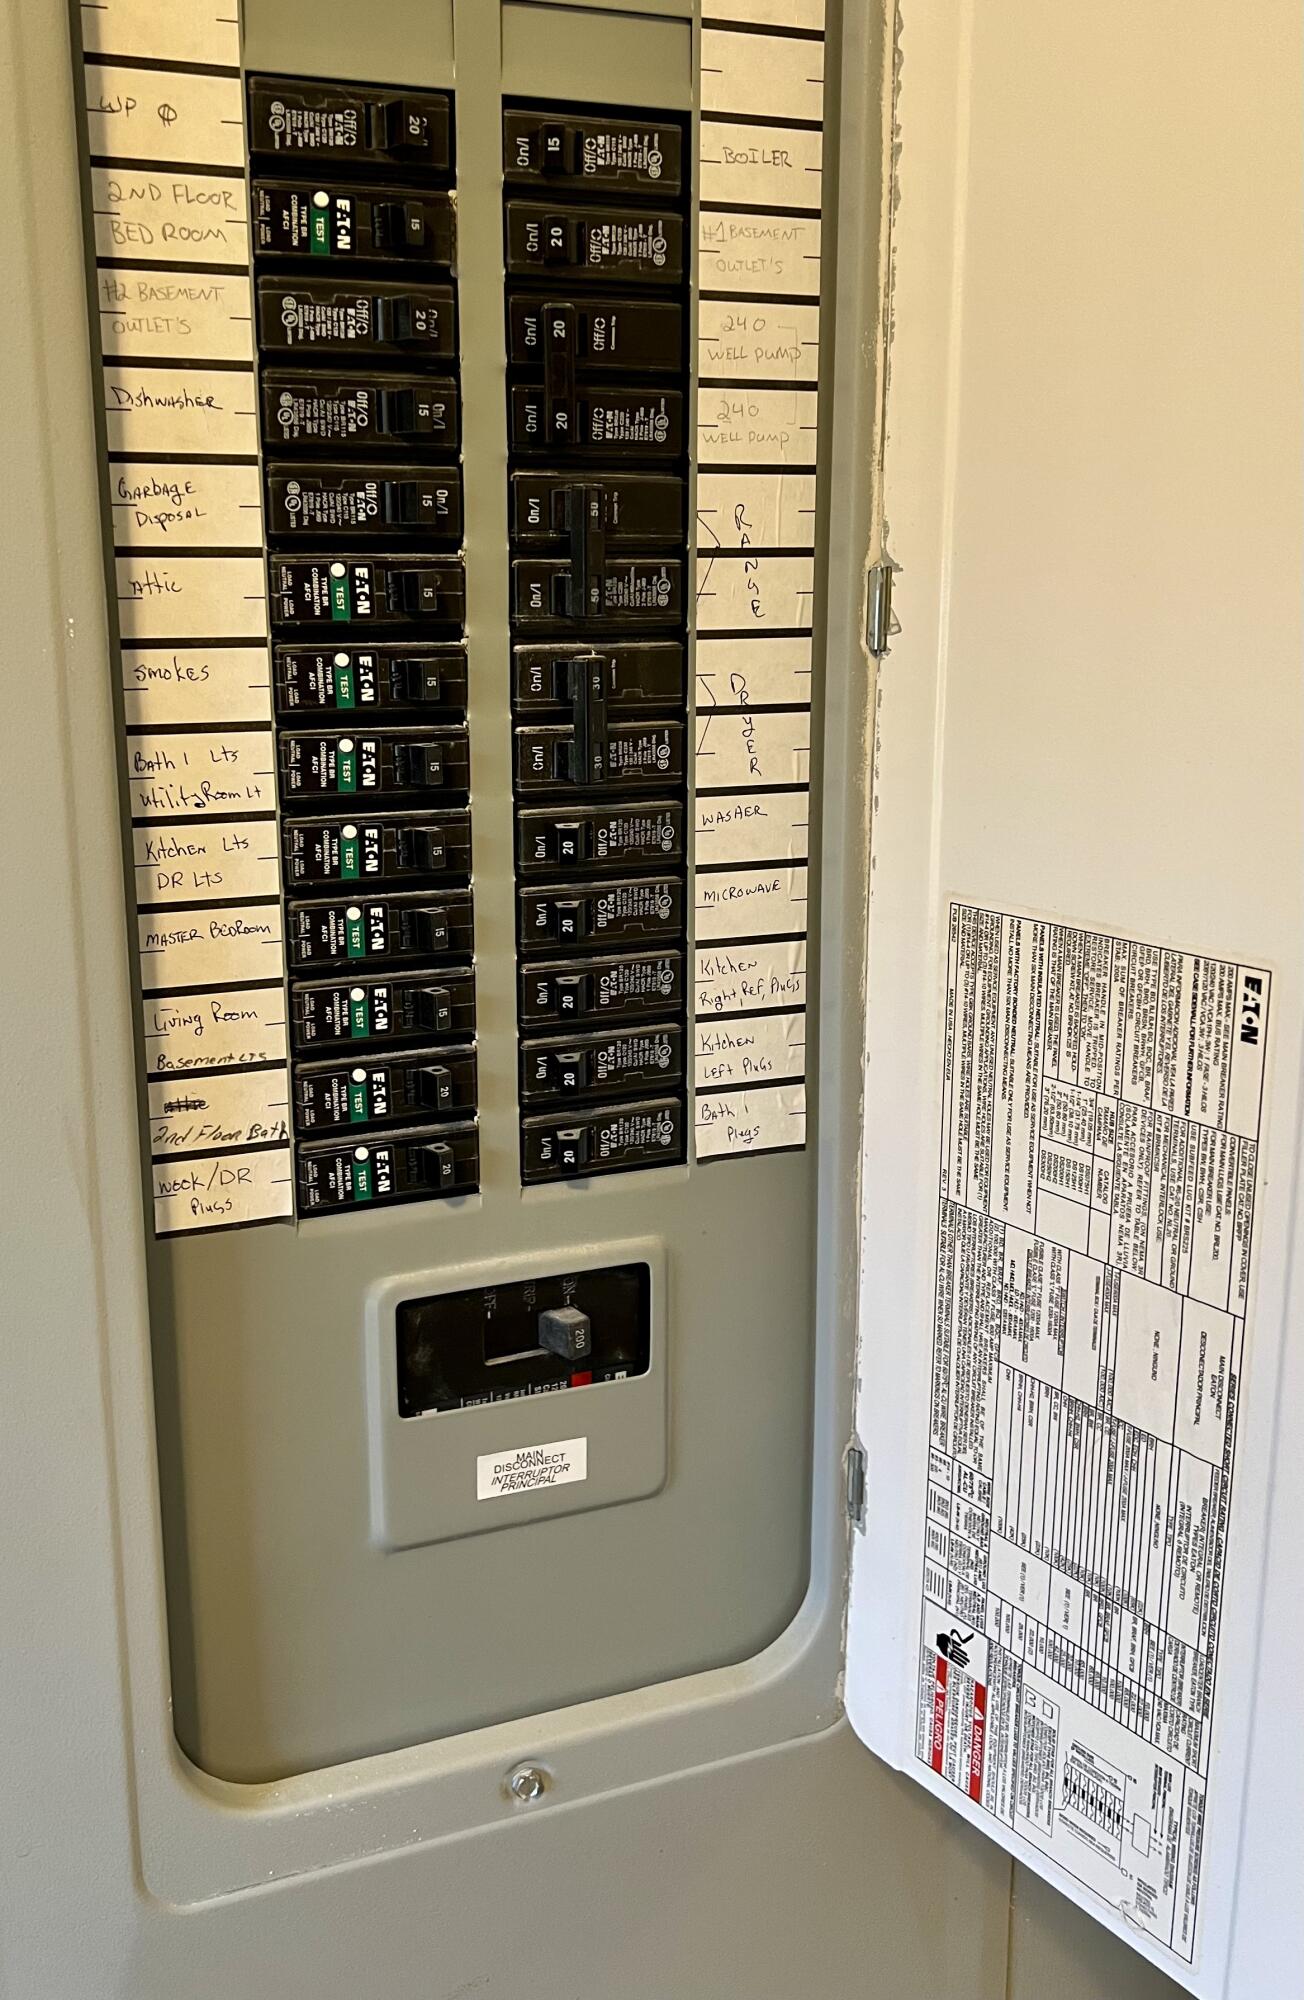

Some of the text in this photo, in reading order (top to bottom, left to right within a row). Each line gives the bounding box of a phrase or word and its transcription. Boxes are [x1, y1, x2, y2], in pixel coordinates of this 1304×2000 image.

[409, 115, 421, 135] 20
[547, 136, 560, 152] 15
[722, 146, 792, 168] BOILER
[107, 181, 238, 212] 2ND FLOOR
[290, 194, 299, 247] COMBINATION
[315, 217, 325, 243] TEST
[410, 218, 420, 231] 15
[110, 220, 228, 245] BED ROOM
[550, 226, 563, 248] 20
[702, 221, 806, 243] #1 BASEMENT
[715, 256, 783, 275] OUTLET'S
[102, 279, 225, 302] #2 BASEMENT
[112, 315, 192, 335] OUTLET'S
[415, 310, 427, 331] 20
[553, 320, 566, 339] 20
[722, 315, 766, 332] 240
[708, 346, 748, 361] WELL
[418, 403, 430, 417] 15
[716, 400, 760, 421] 240
[555, 412, 568, 430] 20
[702, 431, 743, 444] WELL
[422, 494, 433, 507] 15
[590, 502, 599, 517] 50
[311, 567, 320, 616] COMBINATION
[336, 586, 345, 611] TEST
[423, 588, 433, 598] 15
[590, 589, 600, 604] 50
[308, 672, 316, 690] AFCI
[316, 657, 326, 704] COMBINATION
[340, 675, 349, 699] TEST
[427, 677, 437, 687] 15
[592, 676, 600, 690] 30
[311, 755, 319, 774] AFCI
[342, 759, 351, 783] TEST
[430, 762, 440, 772] 15
[594, 755, 603, 769] 30
[323, 829, 331, 875] COMBINATION
[433, 846, 443, 856] 15
[562, 841, 574, 855] 20
[345, 847, 354, 870] TEST
[157, 872, 184, 890] DR
[704, 879, 782, 903] MICROWAVE
[328, 910, 337, 955] COMBINATION
[435, 927, 445, 937] 15
[562, 920, 574, 934] 20
[146, 927, 209, 948] MASTER
[352, 926, 360, 949] TEST
[562, 995, 574, 1009] 20
[1240, 976, 1263, 1045] EATON
[153, 1008, 203, 1037] Living
[325, 1006, 333, 1023] AFCI
[333, 992, 341, 1036] COMBINATION
[355, 1006, 364, 1028] TEST
[438, 1007, 448, 1018] 15
[156, 1053, 236, 1071] Basement
[563, 1072, 575, 1086] 20
[324, 1093, 332, 1109] AFCI
[331, 1078, 340, 1121] COMBINATION
[440, 1086, 450, 1098] 20
[354, 1092, 363, 1114] TEST
[152, 1120, 289, 1146] 2nd Floor Bath
[563, 1150, 575, 1164] 20
[335, 1157, 344, 1200] COMBINATION
[442, 1163, 452, 1175] 20
[327, 1172, 336, 1189] AFCI
[358, 1170, 367, 1192] TEST
[575, 1328, 585, 1349] 200
[493, 1453, 566, 1474] DISCONNECT
[516, 1449, 544, 1463] MAIN
[491, 1463, 571, 1486] INTERRUPTOR
[500, 1473, 557, 1492] PRINCIPAL
[933, 1697, 944, 1750] PELIGRO
[971, 1724, 982, 1777] DANGER
